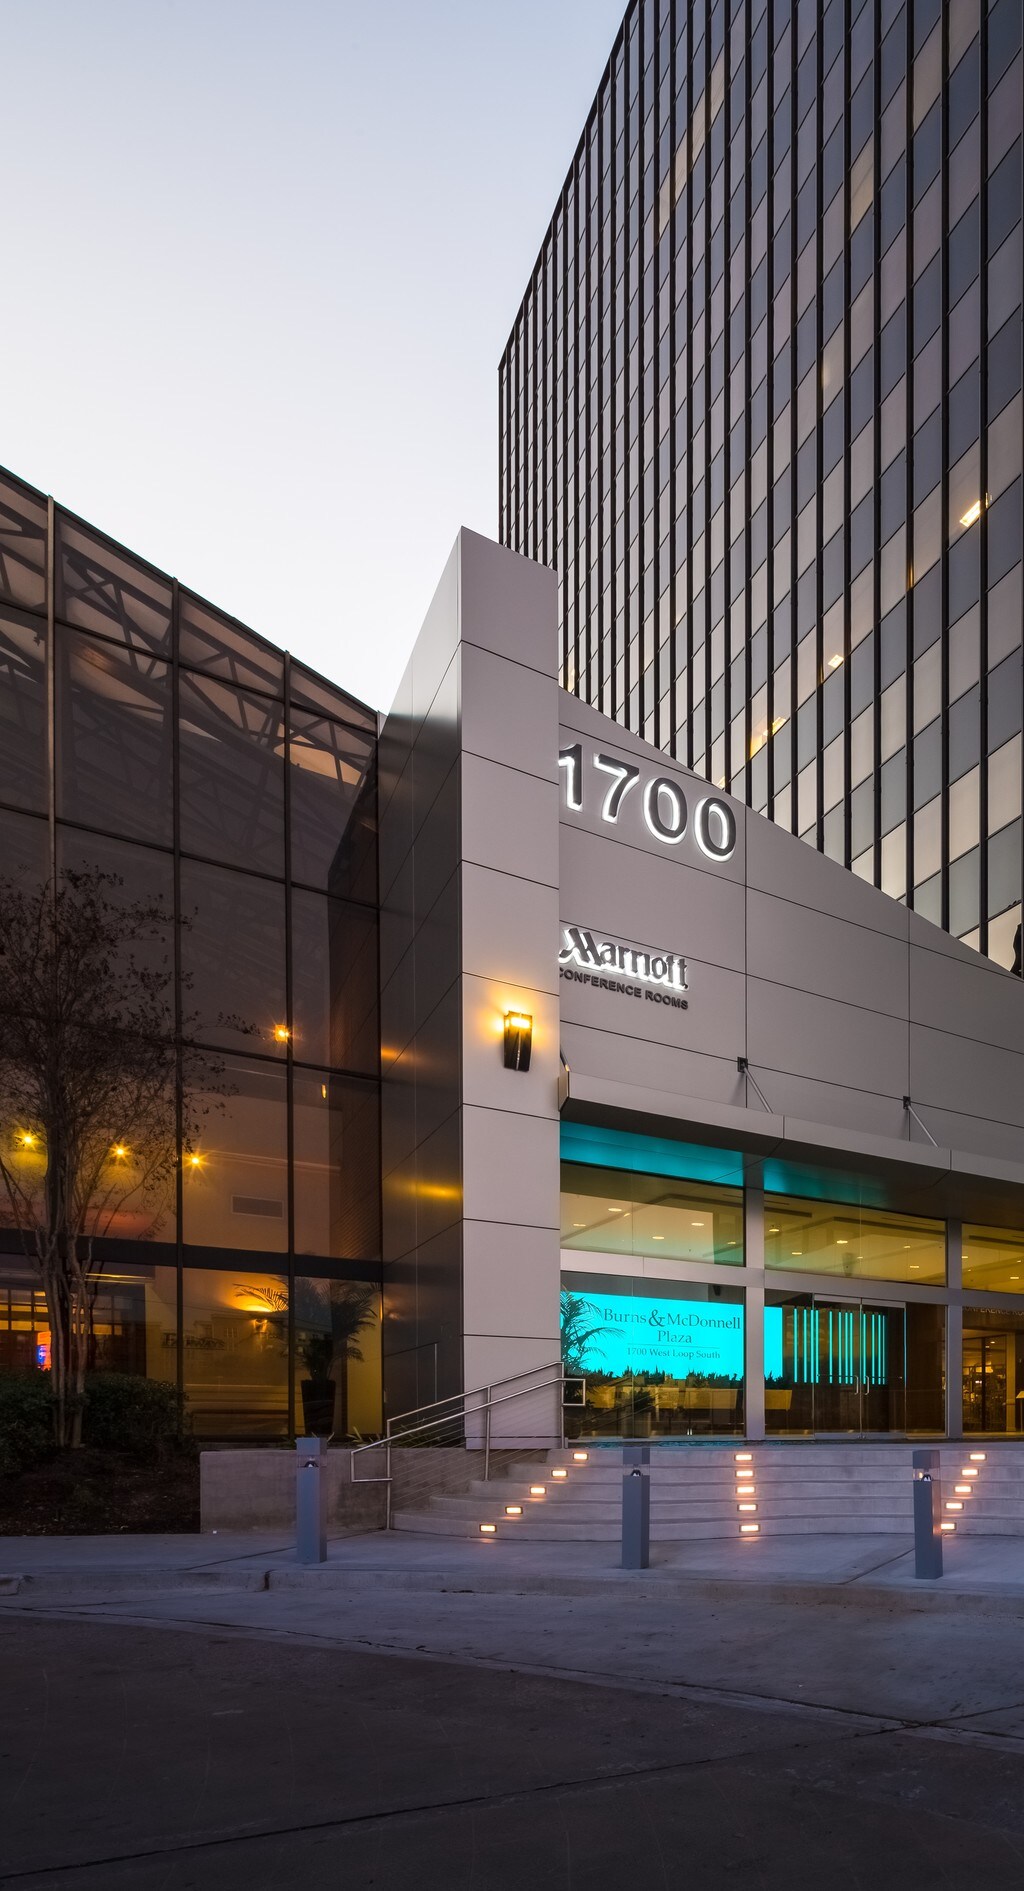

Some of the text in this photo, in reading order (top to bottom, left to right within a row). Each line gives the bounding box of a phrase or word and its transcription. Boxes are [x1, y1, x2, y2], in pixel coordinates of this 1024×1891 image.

[558, 743, 737, 863] 1700
[558, 927, 689, 990] Marriott
[645, 990, 689, 1010] ROOMS
[657, 1330, 693, 1344] Plaza
[626, 1347, 720, 1360] 1700 West Loop South
